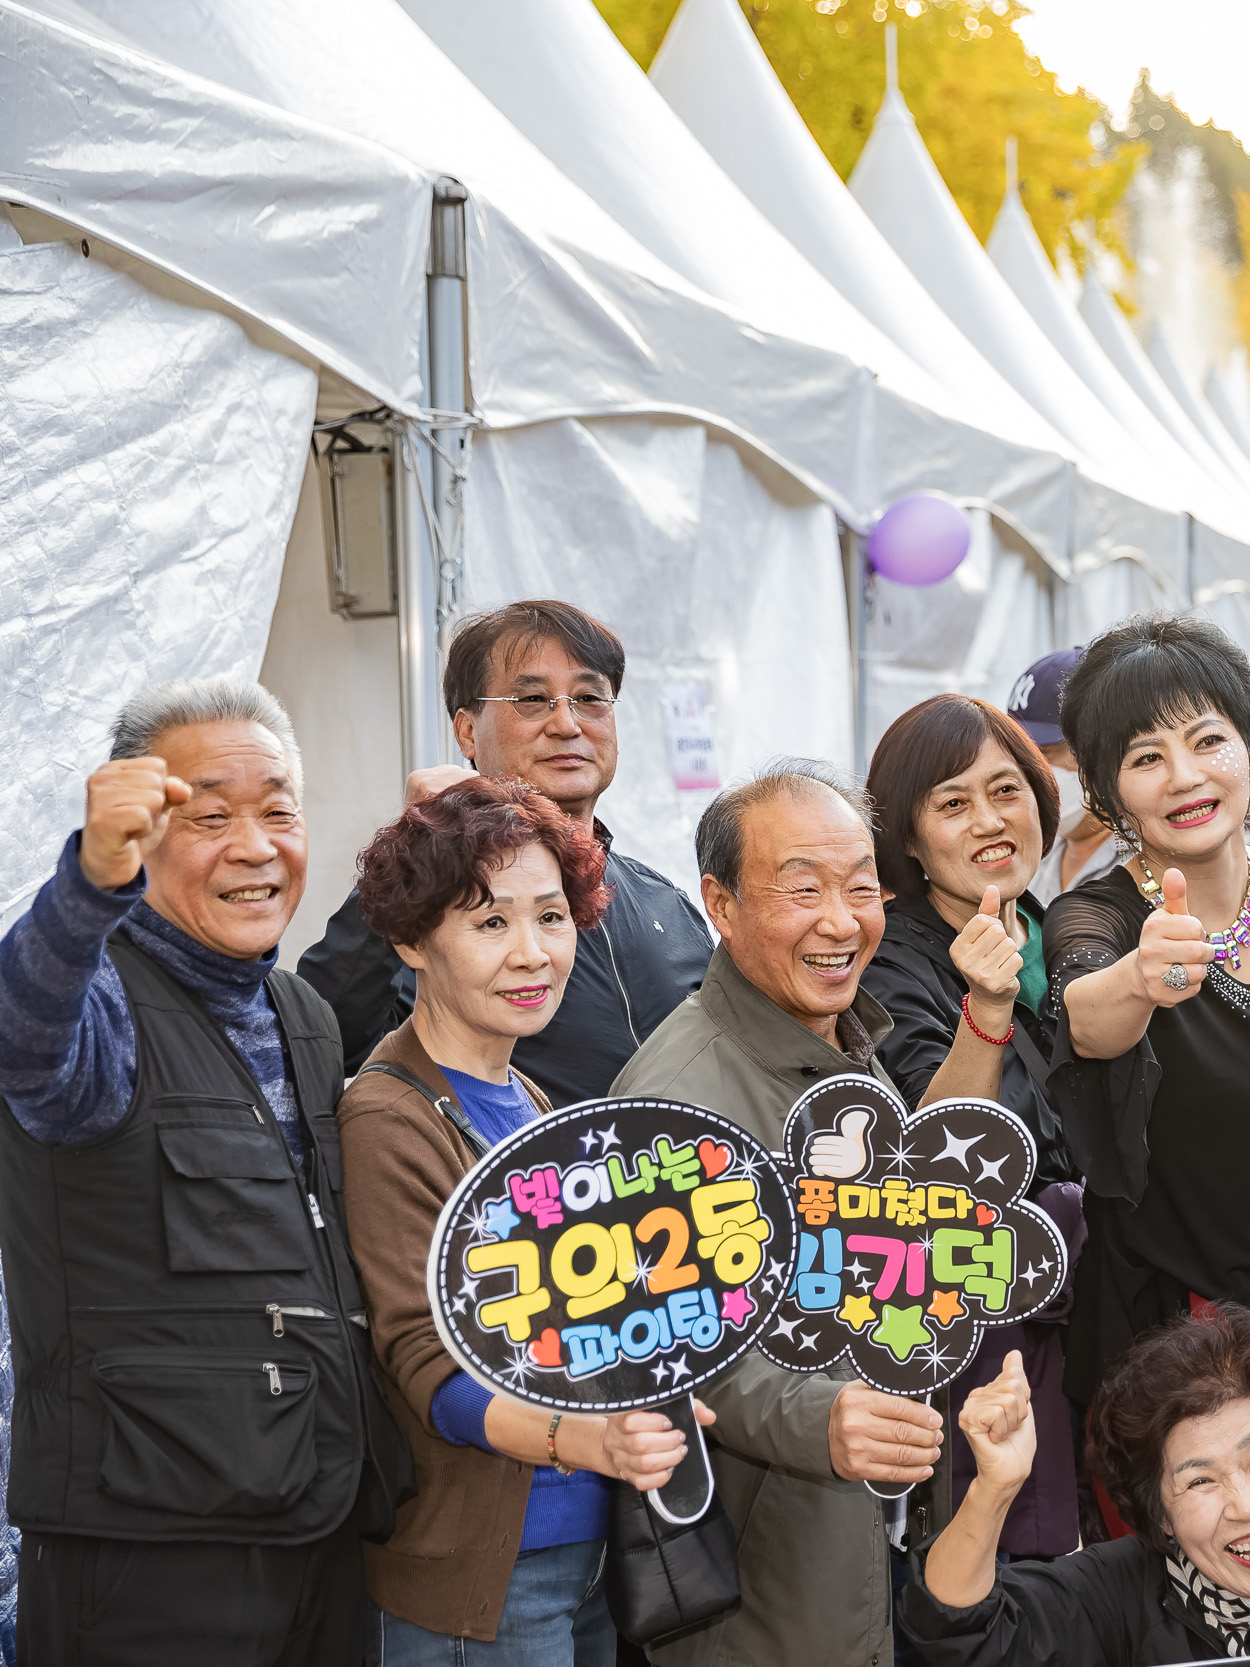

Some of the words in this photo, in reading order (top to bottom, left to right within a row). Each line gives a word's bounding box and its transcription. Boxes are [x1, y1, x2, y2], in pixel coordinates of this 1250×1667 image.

[509, 1139, 701, 1229] 빛이나는
[797, 1179, 974, 1226] 폼미쳤다
[467, 1179, 770, 1342] 구의2동
[560, 1287, 720, 1377] 파이팅
